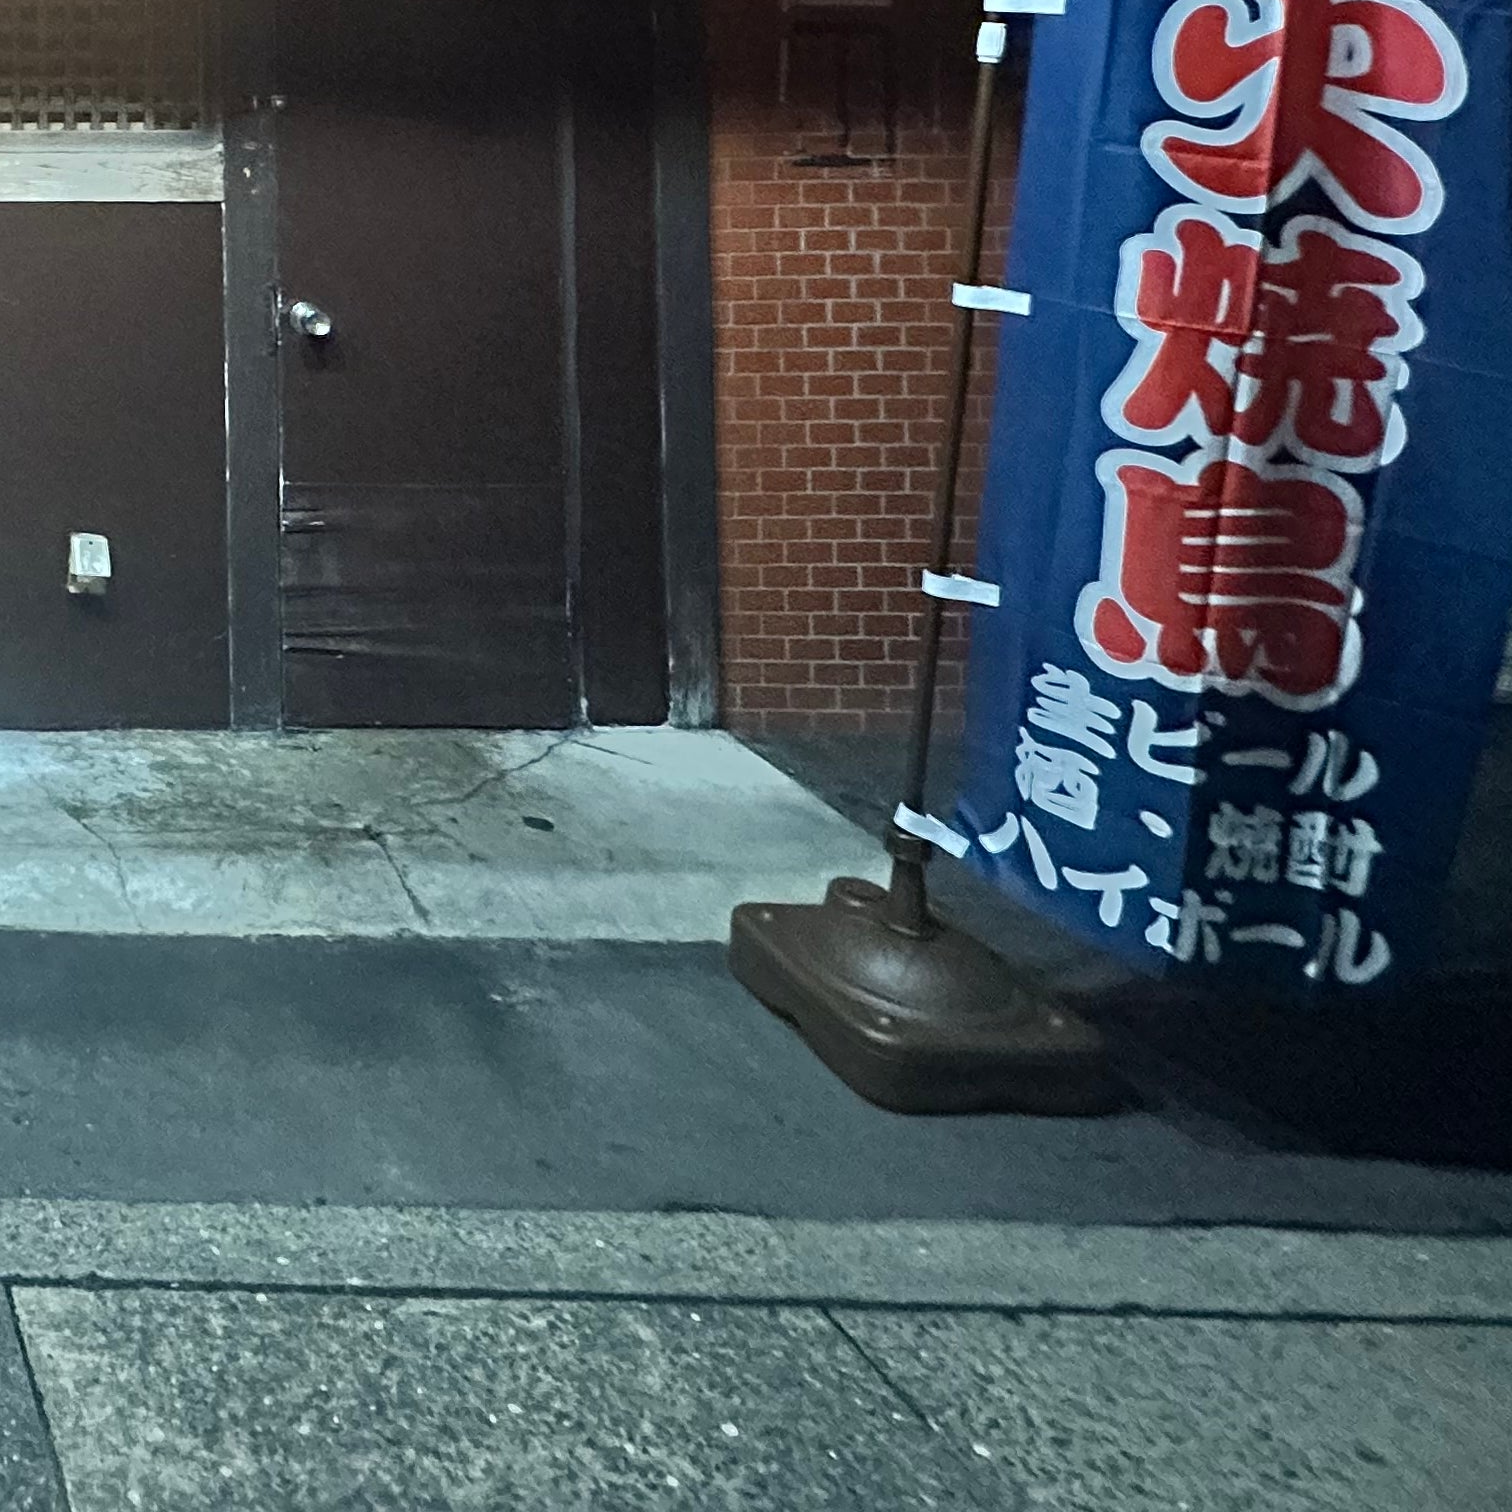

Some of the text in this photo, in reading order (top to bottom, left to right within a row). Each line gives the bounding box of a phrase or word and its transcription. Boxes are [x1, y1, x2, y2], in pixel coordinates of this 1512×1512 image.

[978, 811, 1392, 985] ハイボール
